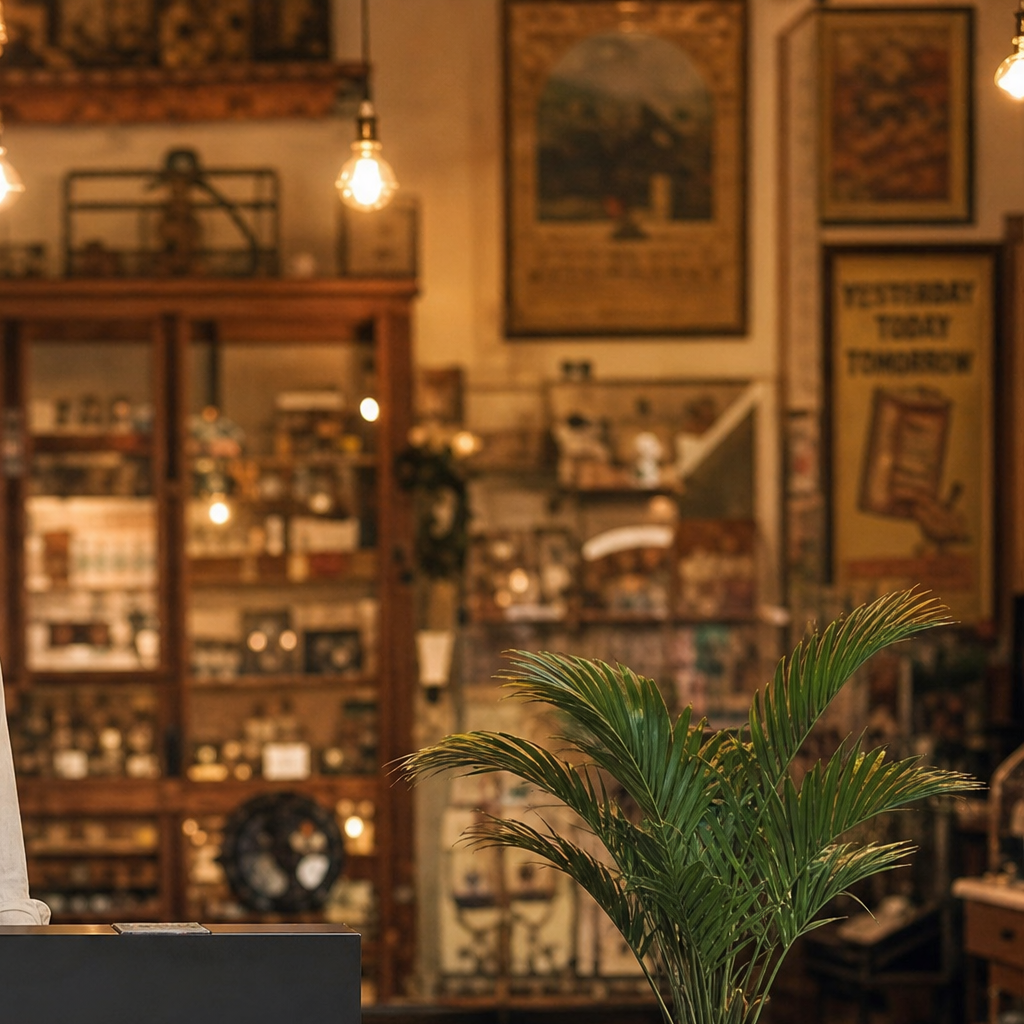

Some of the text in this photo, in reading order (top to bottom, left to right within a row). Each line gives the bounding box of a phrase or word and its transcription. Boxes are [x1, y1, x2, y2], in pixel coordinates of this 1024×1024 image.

[843, 280, 975, 311] YESTERDAY
[875, 314, 951, 340] TODAY
[846, 350, 974, 378] TOMORROW
